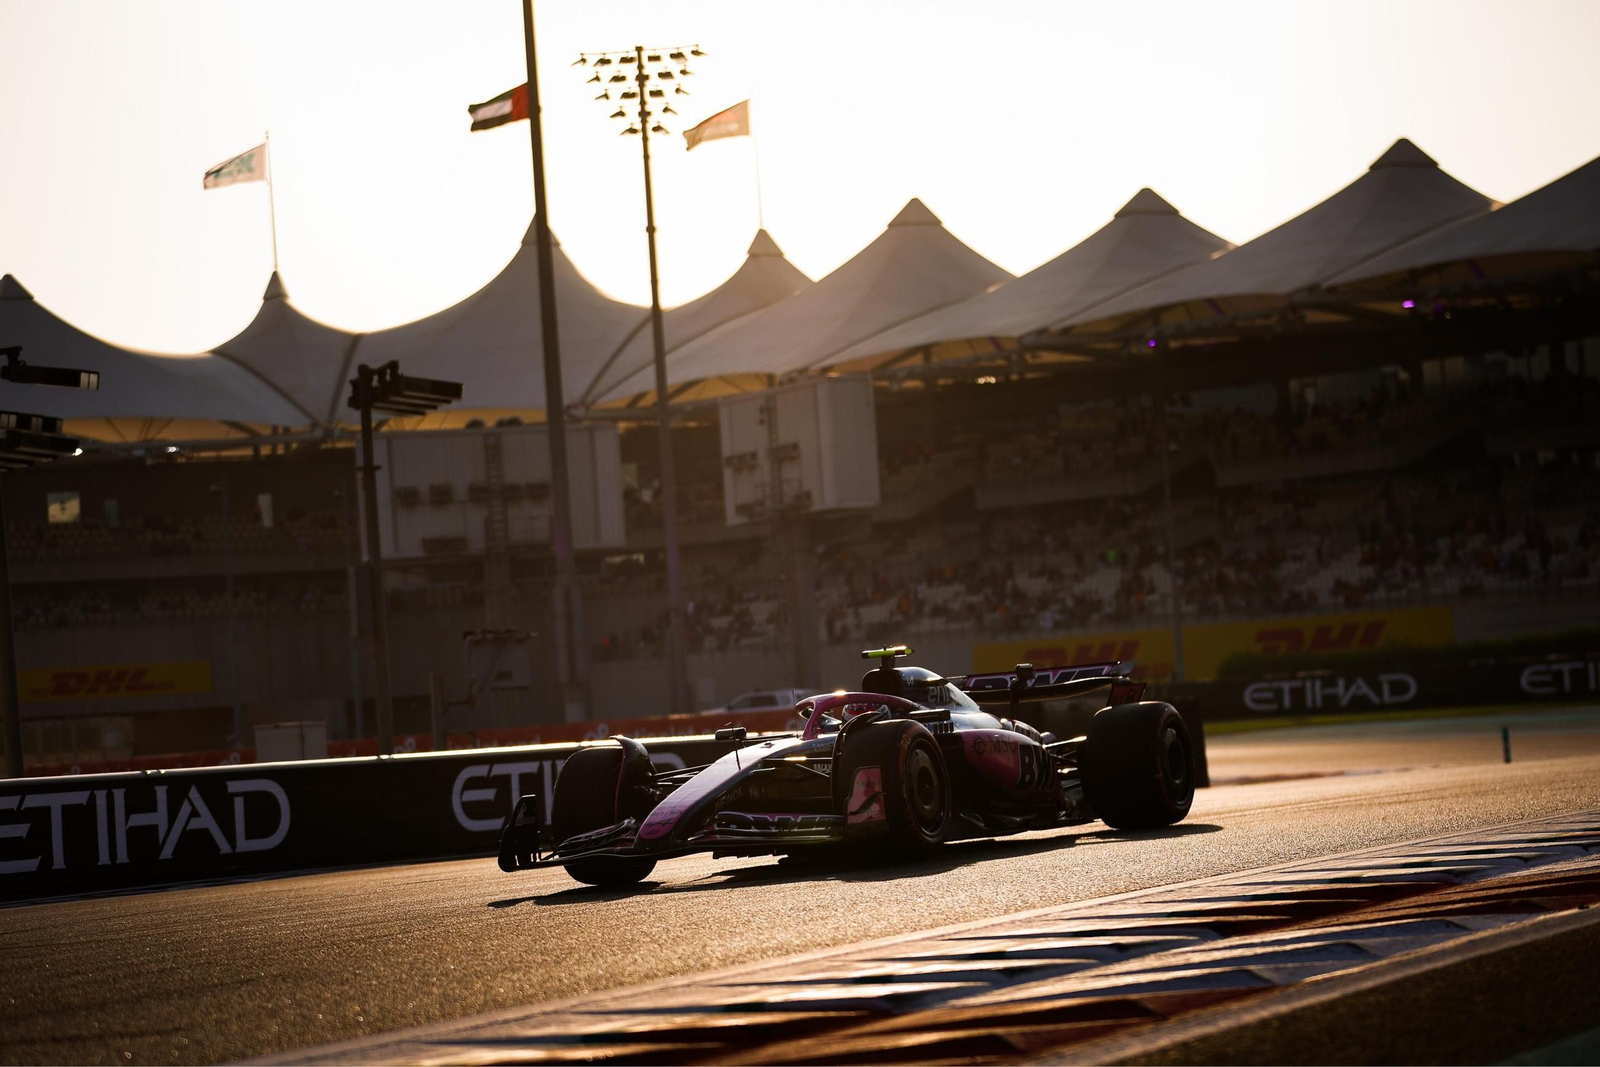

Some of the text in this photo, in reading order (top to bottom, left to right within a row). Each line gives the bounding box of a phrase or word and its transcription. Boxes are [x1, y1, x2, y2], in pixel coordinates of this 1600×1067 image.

[50, 668, 155, 696] DHL
[1243, 672, 1418, 712] ETIHAD
[1520, 660, 1600, 695] ETI
[0, 778, 291, 874] ETIHAD
